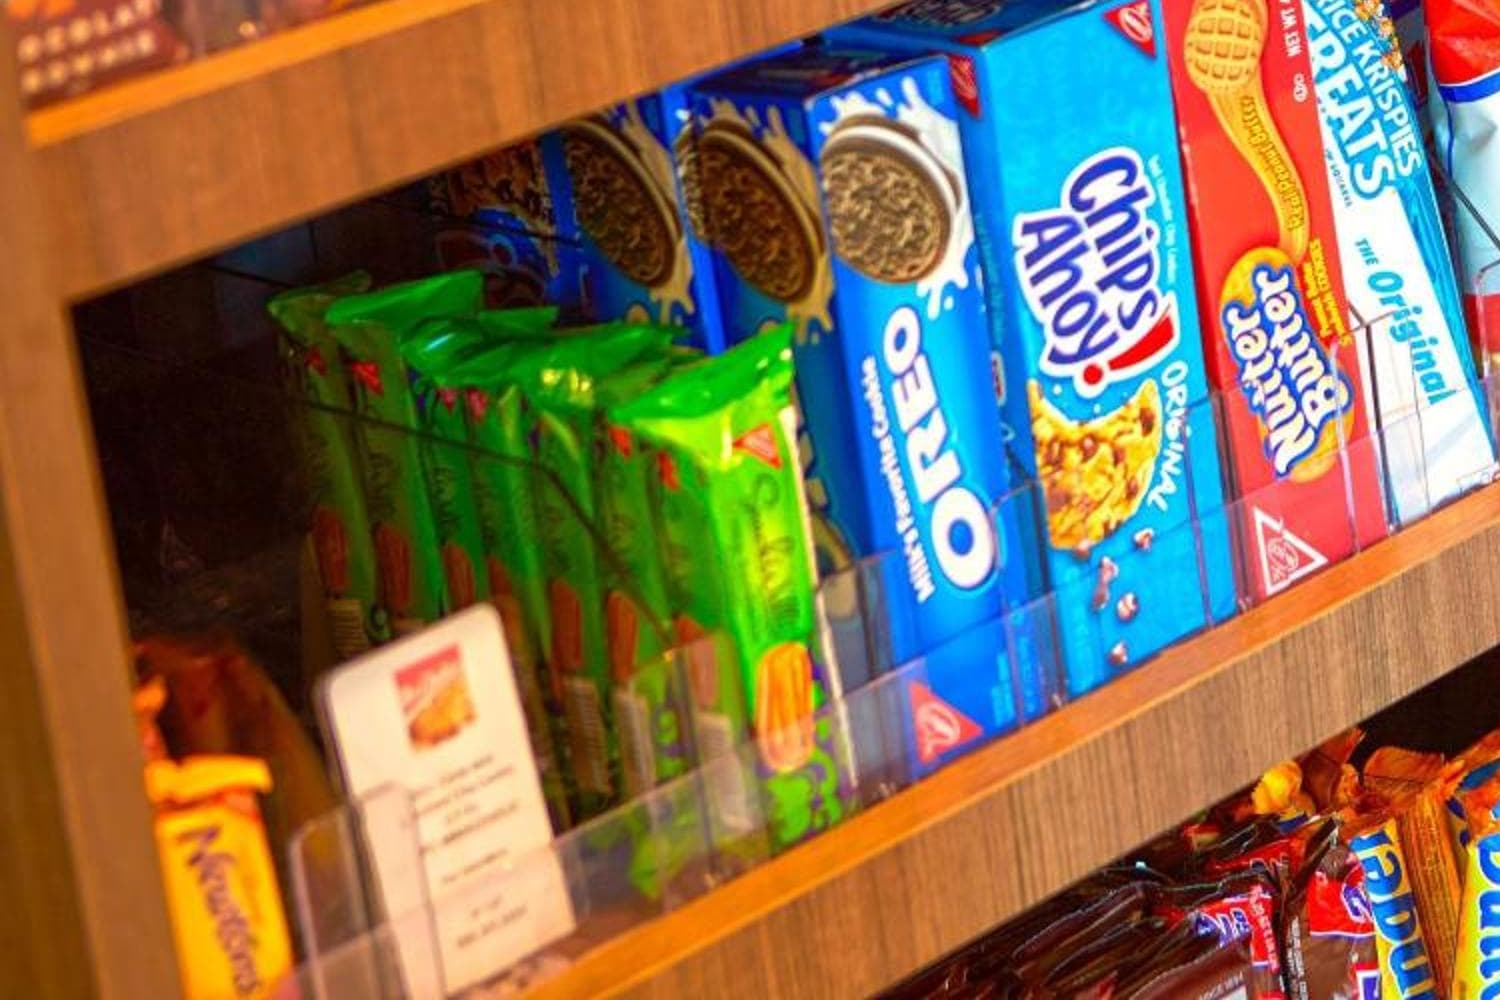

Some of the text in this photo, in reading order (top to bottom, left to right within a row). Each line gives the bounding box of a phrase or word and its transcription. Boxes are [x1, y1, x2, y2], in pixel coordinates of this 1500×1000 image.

[1352, 38, 1423, 182] KRISPIES
[1069, 151, 1160, 336] Chips
[1355, 236, 1380, 268] THE
[1226, 305, 1318, 477] Nutter
[1254, 268, 1350, 432] Butter
[1366, 270, 1459, 408] Original
[878, 432, 916, 537] Favorite
[881, 304, 997, 590] OREO
[1145, 359, 1191, 513] ORIGINAL
